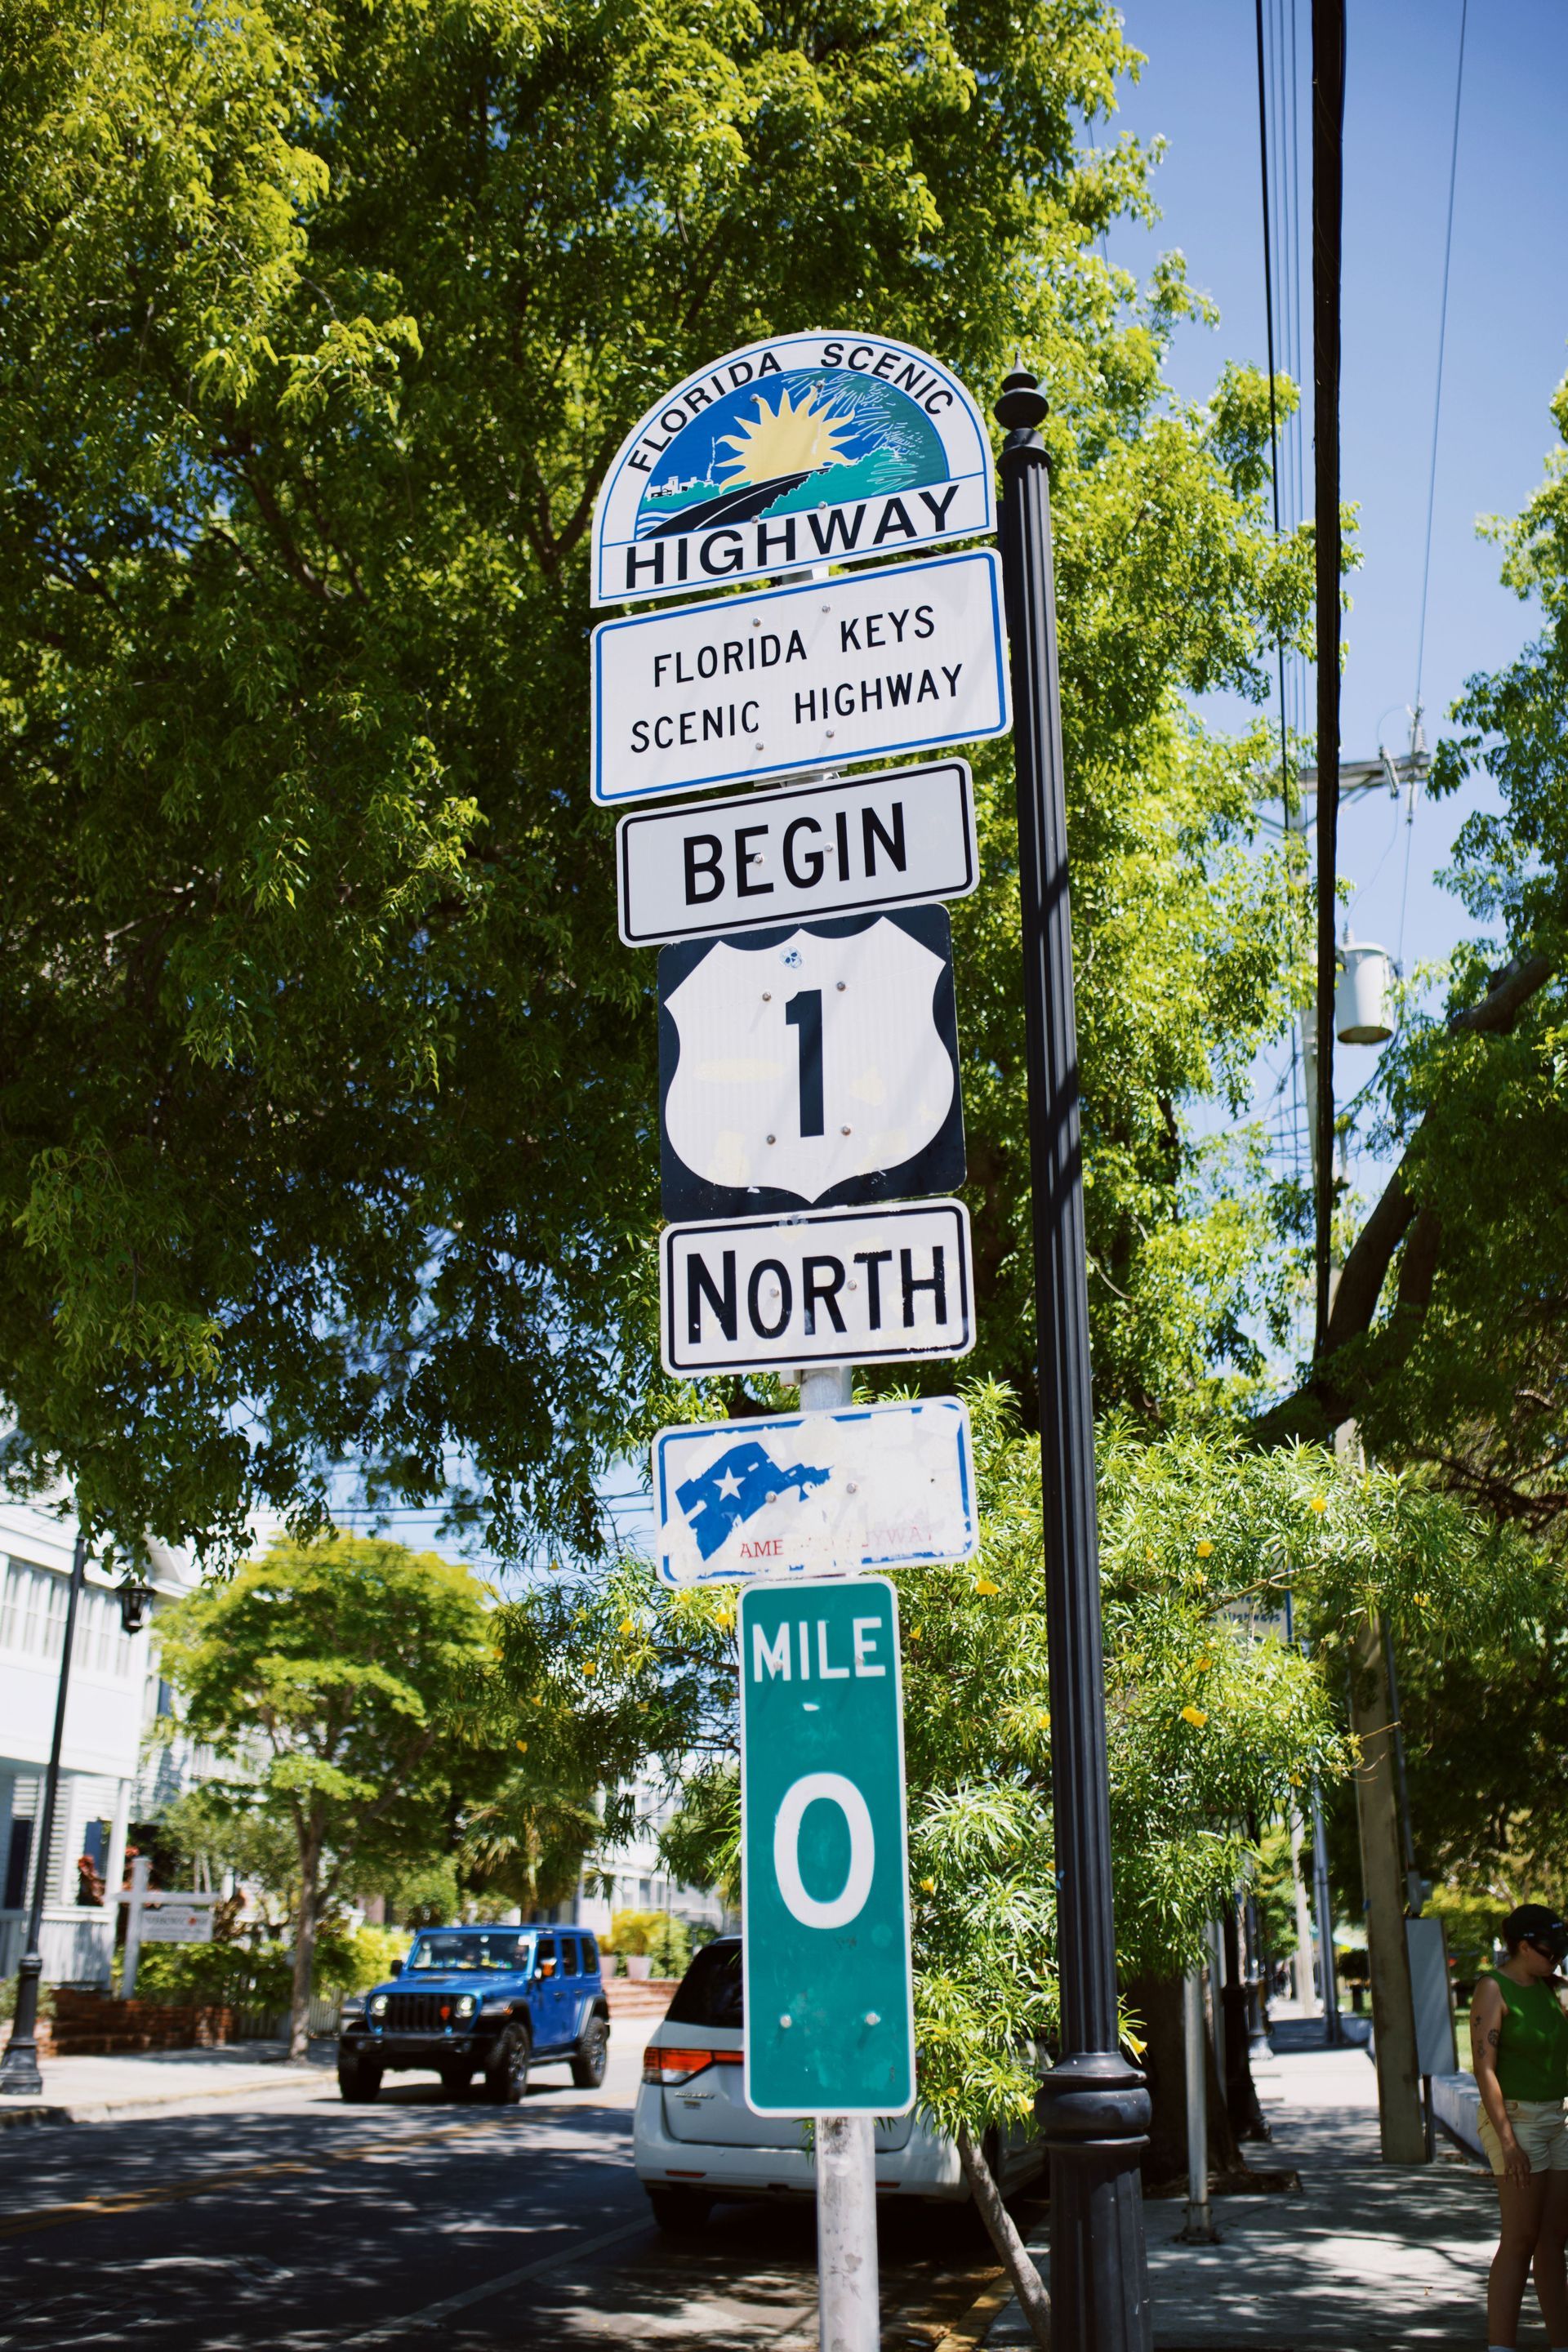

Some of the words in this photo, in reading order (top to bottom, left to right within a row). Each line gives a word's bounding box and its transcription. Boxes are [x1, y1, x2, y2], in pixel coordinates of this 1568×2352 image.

[628, 352, 782, 473] FLORIDA
[820, 342, 953, 415] SCENIC
[626, 484, 960, 590] HIGHWAY
[654, 629, 808, 688] FLORIDA
[840, 605, 935, 653] KEYS
[630, 701, 760, 754] SCENIC
[795, 663, 963, 724] HIGHWAY
[683, 801, 906, 906] BEGIN
[785, 989, 825, 1138] 1
[687, 1245, 947, 1344] NORTH
[753, 1617, 886, 1682] MILE
[773, 1772, 875, 1929] 0
